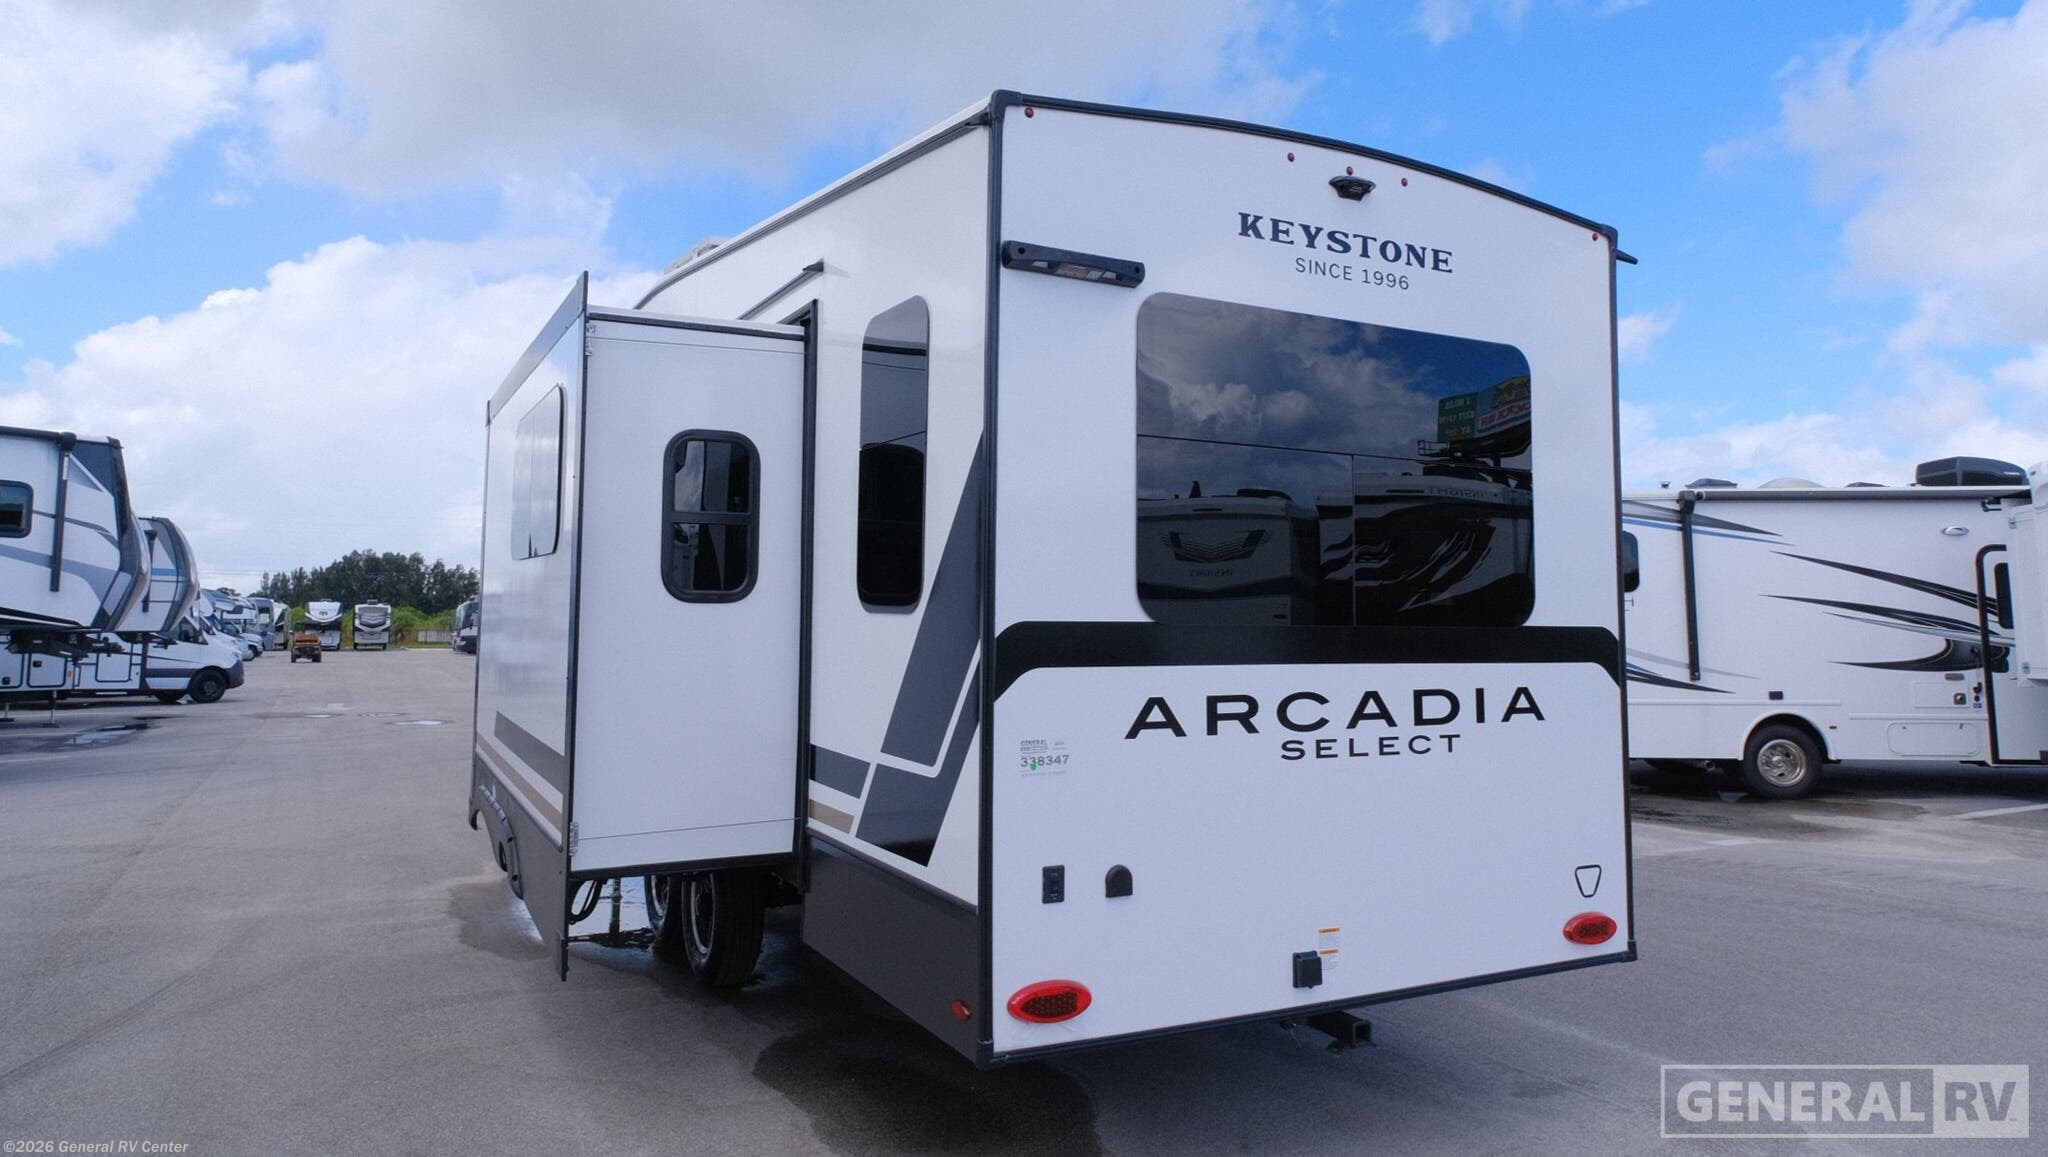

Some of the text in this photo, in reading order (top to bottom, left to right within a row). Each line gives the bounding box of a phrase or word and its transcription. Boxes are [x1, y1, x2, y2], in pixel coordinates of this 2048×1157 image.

[1237, 211, 1453, 273] KEYSTONE
[1295, 257, 1410, 290] SINCE 1996
[1123, 686, 1546, 739] ARCADIA
[1020, 754, 1070, 767] 338347
[1280, 733, 1461, 761] SELECT
